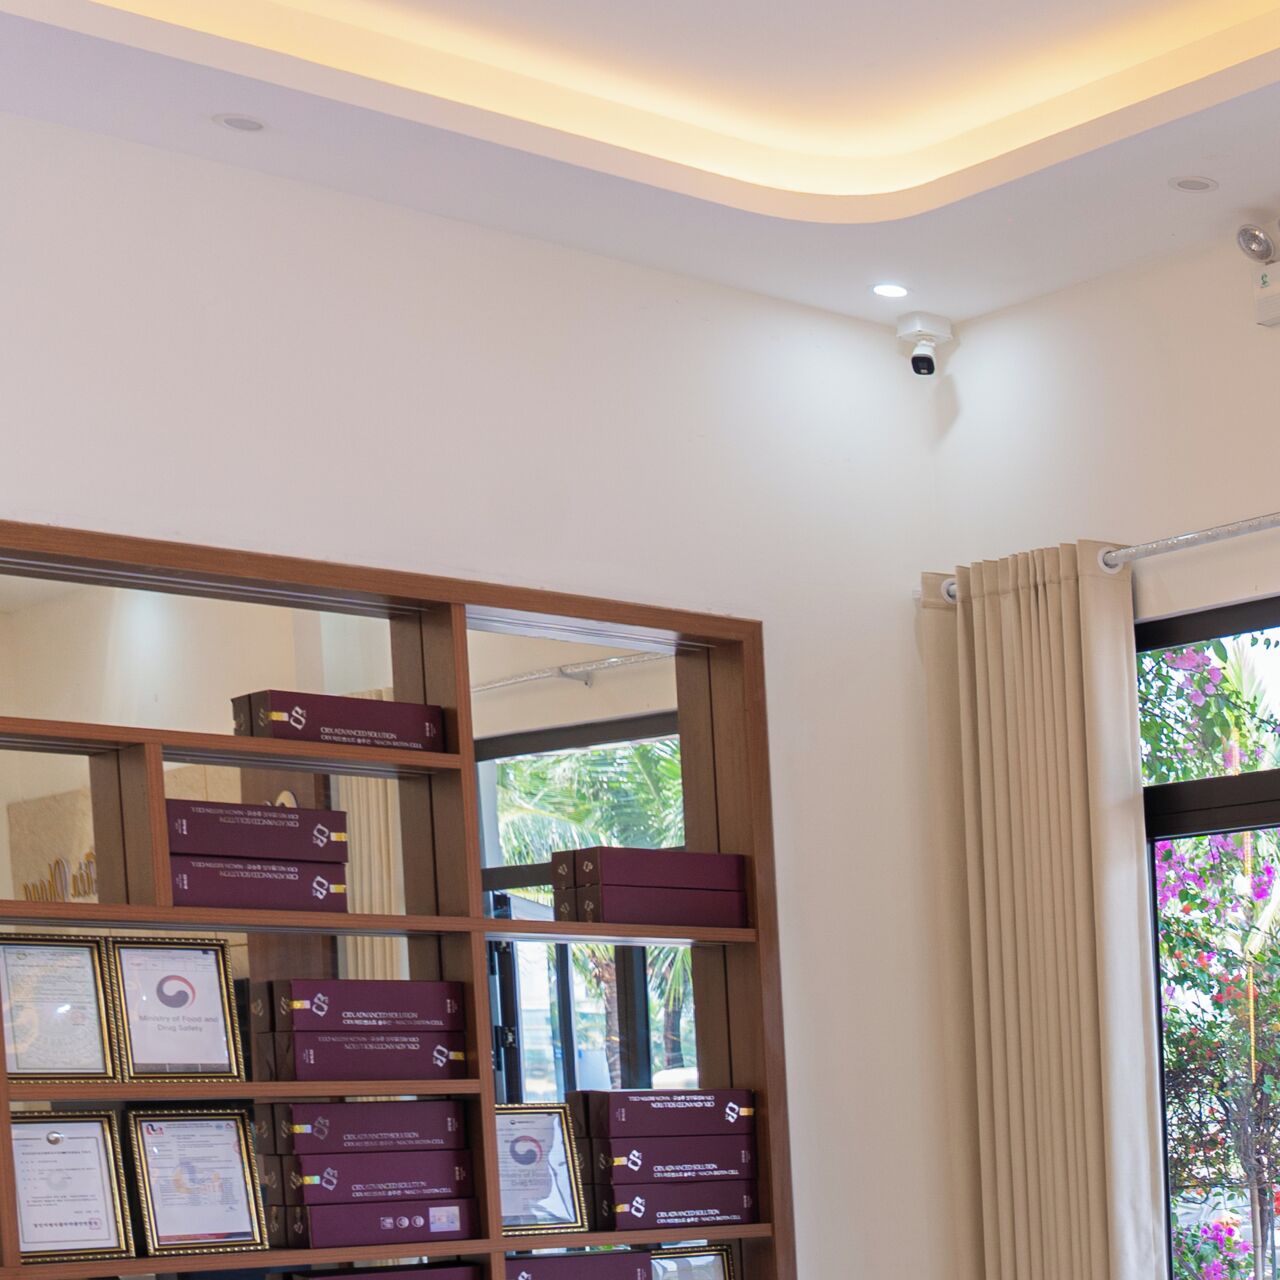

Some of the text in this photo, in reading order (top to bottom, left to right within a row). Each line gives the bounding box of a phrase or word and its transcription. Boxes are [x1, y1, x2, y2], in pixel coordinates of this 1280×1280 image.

[334, 728, 366, 737] ADVANCED
[366, 730, 397, 739] SOLUTION
[182, 1015, 202, 1023] Food
[665, 1164, 693, 1172] ADVANCED
[693, 1163, 718, 1171] SOLUTION
